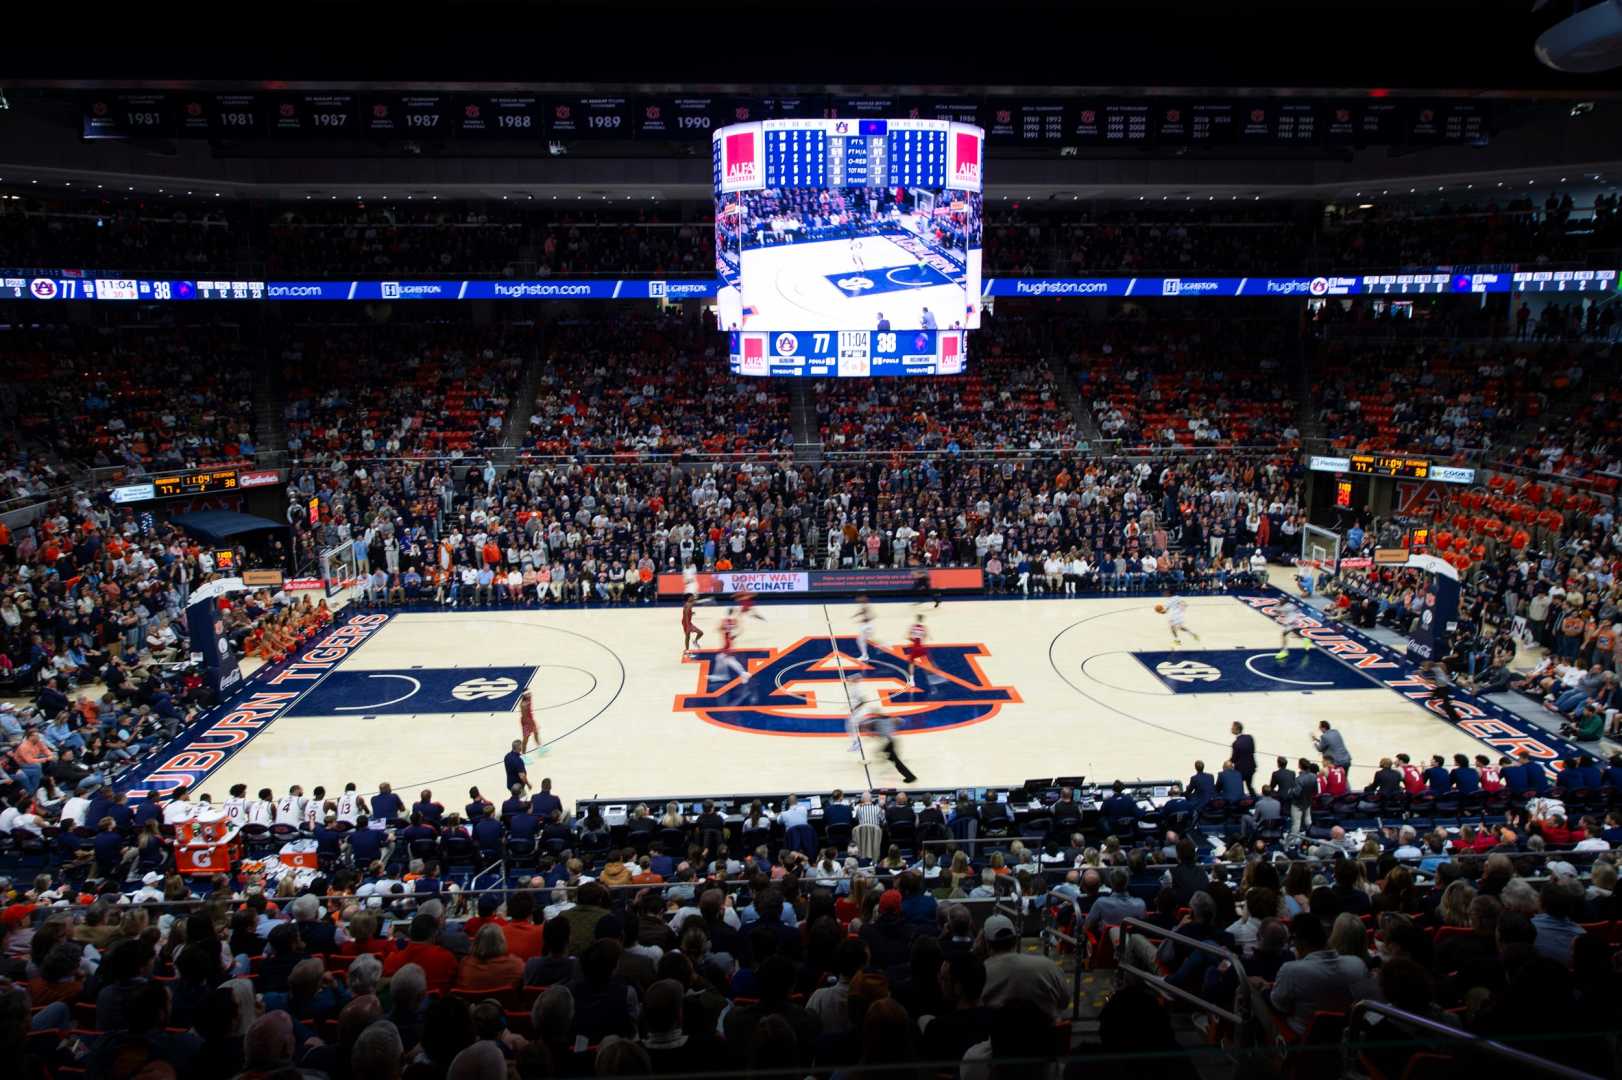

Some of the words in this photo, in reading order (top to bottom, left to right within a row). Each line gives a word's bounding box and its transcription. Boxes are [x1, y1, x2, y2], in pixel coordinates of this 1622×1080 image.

[128, 112, 161, 126] 1981
[220, 112, 253, 126] 1981
[312, 113, 347, 127] 1987
[406, 114, 439, 128] 1987
[498, 115, 531, 128] 1988
[588, 115, 621, 128] 1989
[678, 115, 710, 128] 1990
[729, 161, 755, 177] ALFA
[59, 280, 76, 299] 77
[101, 280, 134, 289] 11:04
[153, 281, 171, 299] 38
[495, 283, 591, 297] hughston.com
[1016, 280, 1107, 294] hughston.com
[813, 333, 831, 353] 77
[842, 333, 867, 347] 11:04
[161, 485, 174, 495] 77
[224, 479, 236, 488] 38
[731, 574, 767, 582] DON'T
[769, 573, 801, 583] WAIT,
[731, 582, 794, 591] VACCINATE
[268, 613, 390, 684] TIGERS
[227, 806, 238, 818] 10
[282, 802, 291, 813] 4
[341, 803, 351, 815] 13
[255, 809, 260, 821] 1
[293, 855, 304, 865] G
